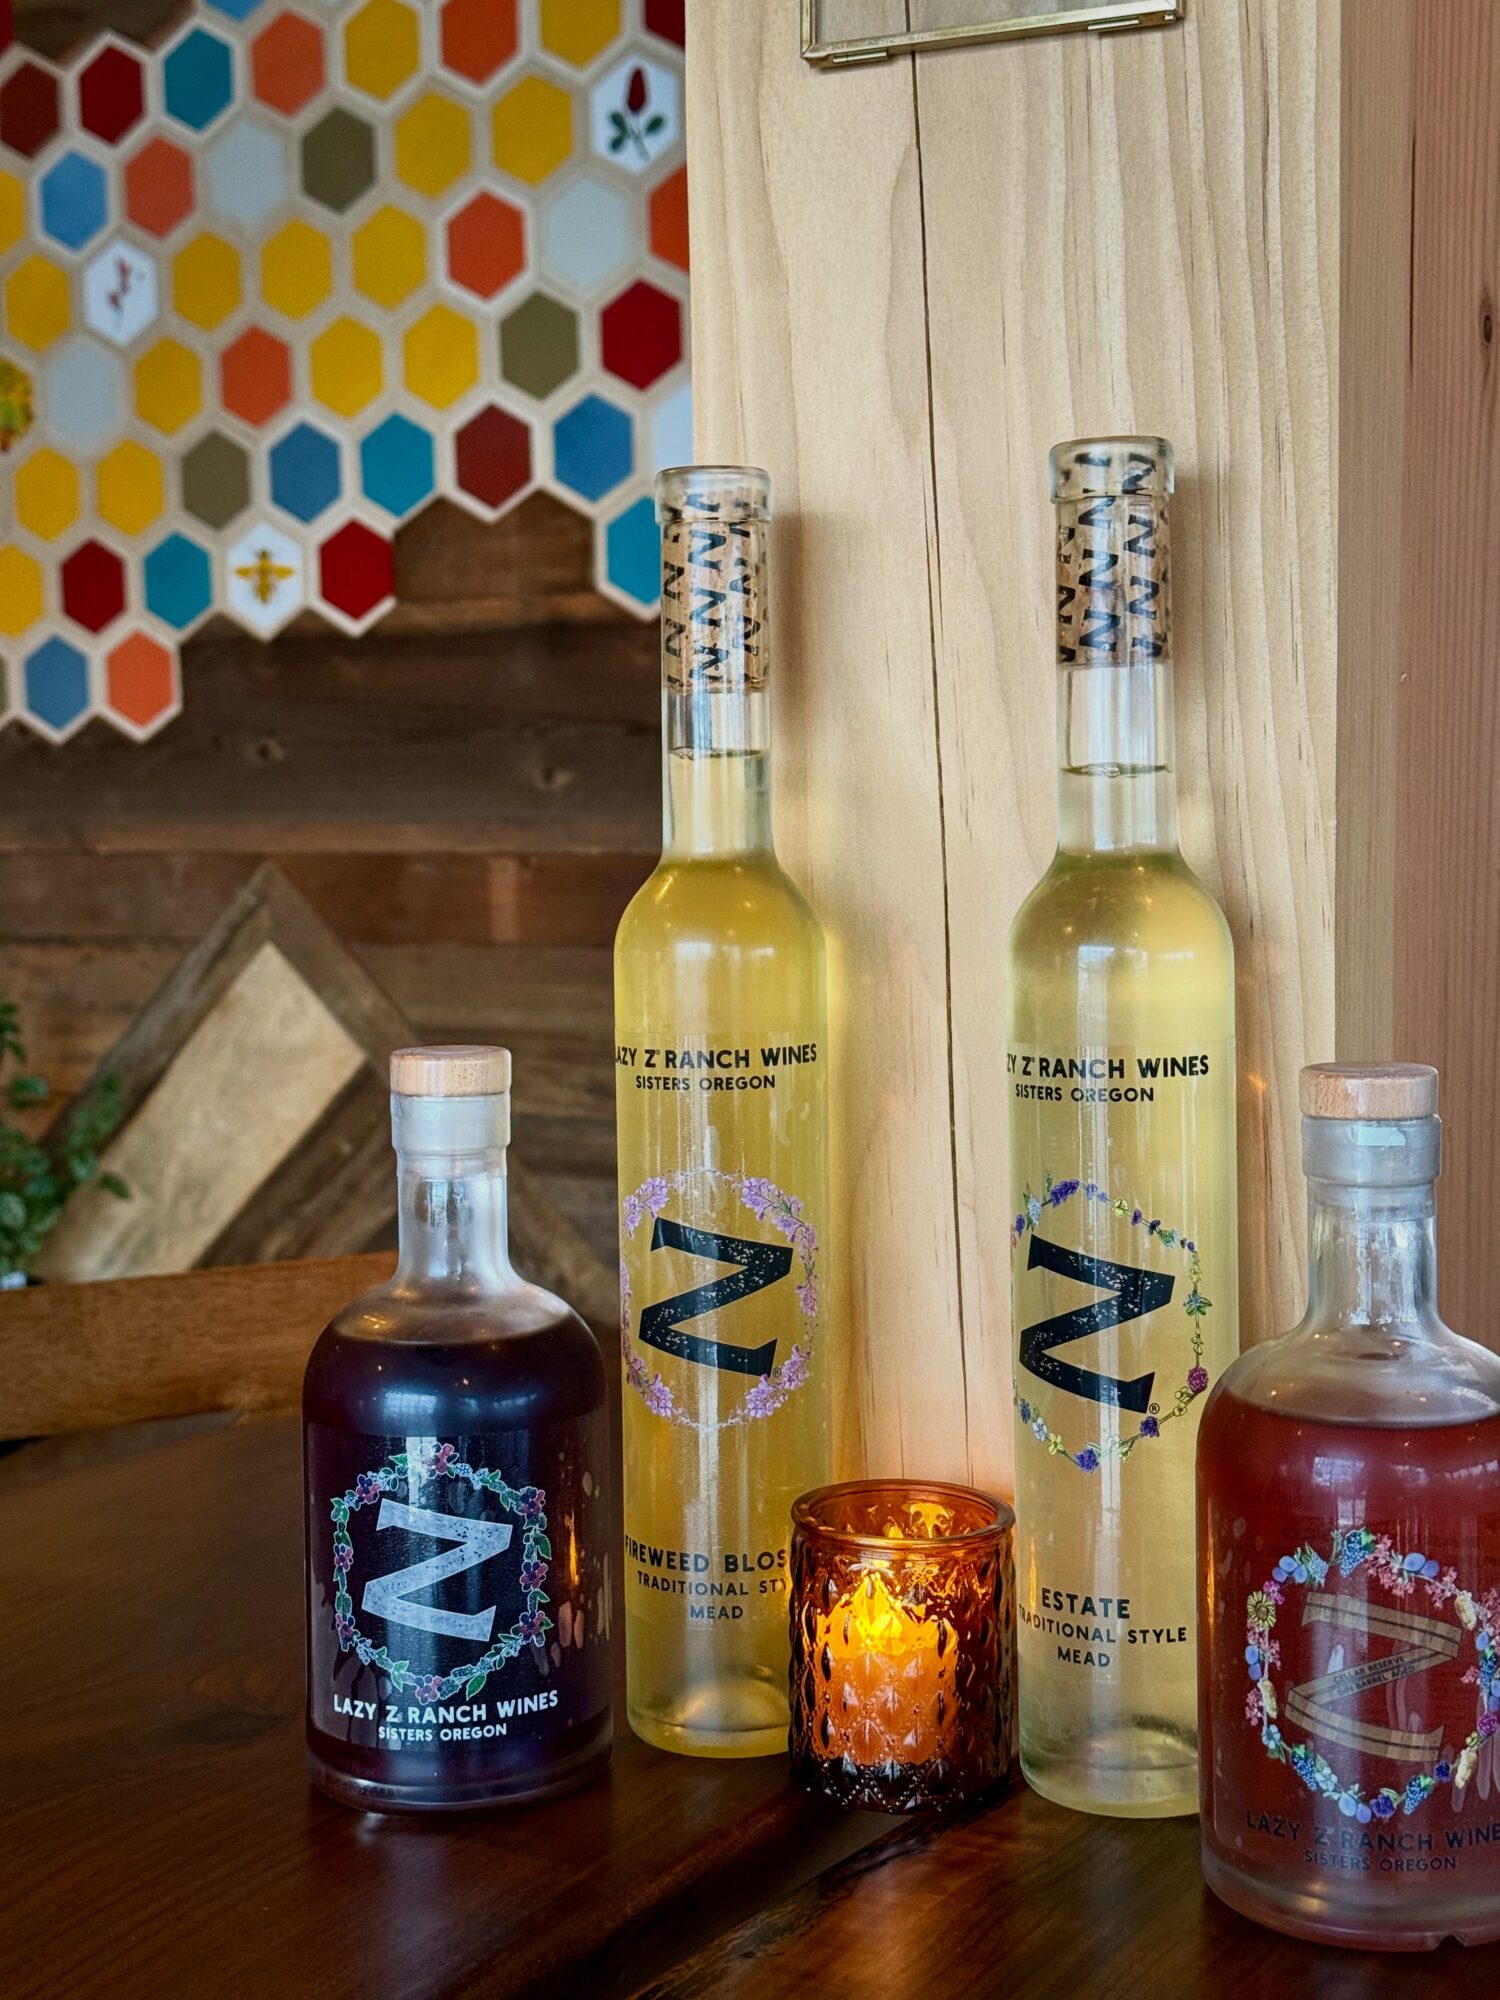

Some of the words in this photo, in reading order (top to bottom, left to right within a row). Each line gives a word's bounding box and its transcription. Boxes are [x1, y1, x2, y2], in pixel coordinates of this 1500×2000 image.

[615, 1045, 637, 1067] AZY
[665, 1049, 750, 1069] RANCH
[760, 1043, 817, 1067] WINES
[1007, 1053, 1017, 1074] ZY
[1039, 1057, 1125, 1079] RANCH
[1137, 1054, 1209, 1078] WINES
[635, 1075, 690, 1091] SISTERS
[699, 1074, 776, 1091] OREGON
[1015, 1083, 1063, 1101] SISTERS
[1070, 1086, 1154, 1103] OREGON
[625, 1534, 710, 1573] FIREWEED
[724, 1549, 787, 1573] BLOS
[637, 1570, 749, 1596] TRADITIONAL
[759, 1578, 787, 1594] STY
[690, 1605, 743, 1620] MEAD
[1041, 1587, 1131, 1619] ESTATE
[1018, 1603, 1117, 1643] TRADITIONAL
[1127, 1627, 1188, 1644] STYLE
[1057, 1645, 1111, 1668] MEAD
[333, 1694, 377, 1721] LAZY
[385, 1705, 401, 1723] Z
[408, 1704, 487, 1724] RANCH
[496, 1689, 559, 1719] WINES
[378, 1726, 433, 1742] SISTERS
[439, 1723, 507, 1742] OREGON
[1246, 1810, 1300, 1841] LAZY
[1314, 1826, 1329, 1846] Z
[1340, 1831, 1433, 1851] RANCH
[1445, 1822, 1500, 1849] WINE
[1304, 1852, 1371, 1871] SISTERS
[1379, 1856, 1457, 1873] OREGON
